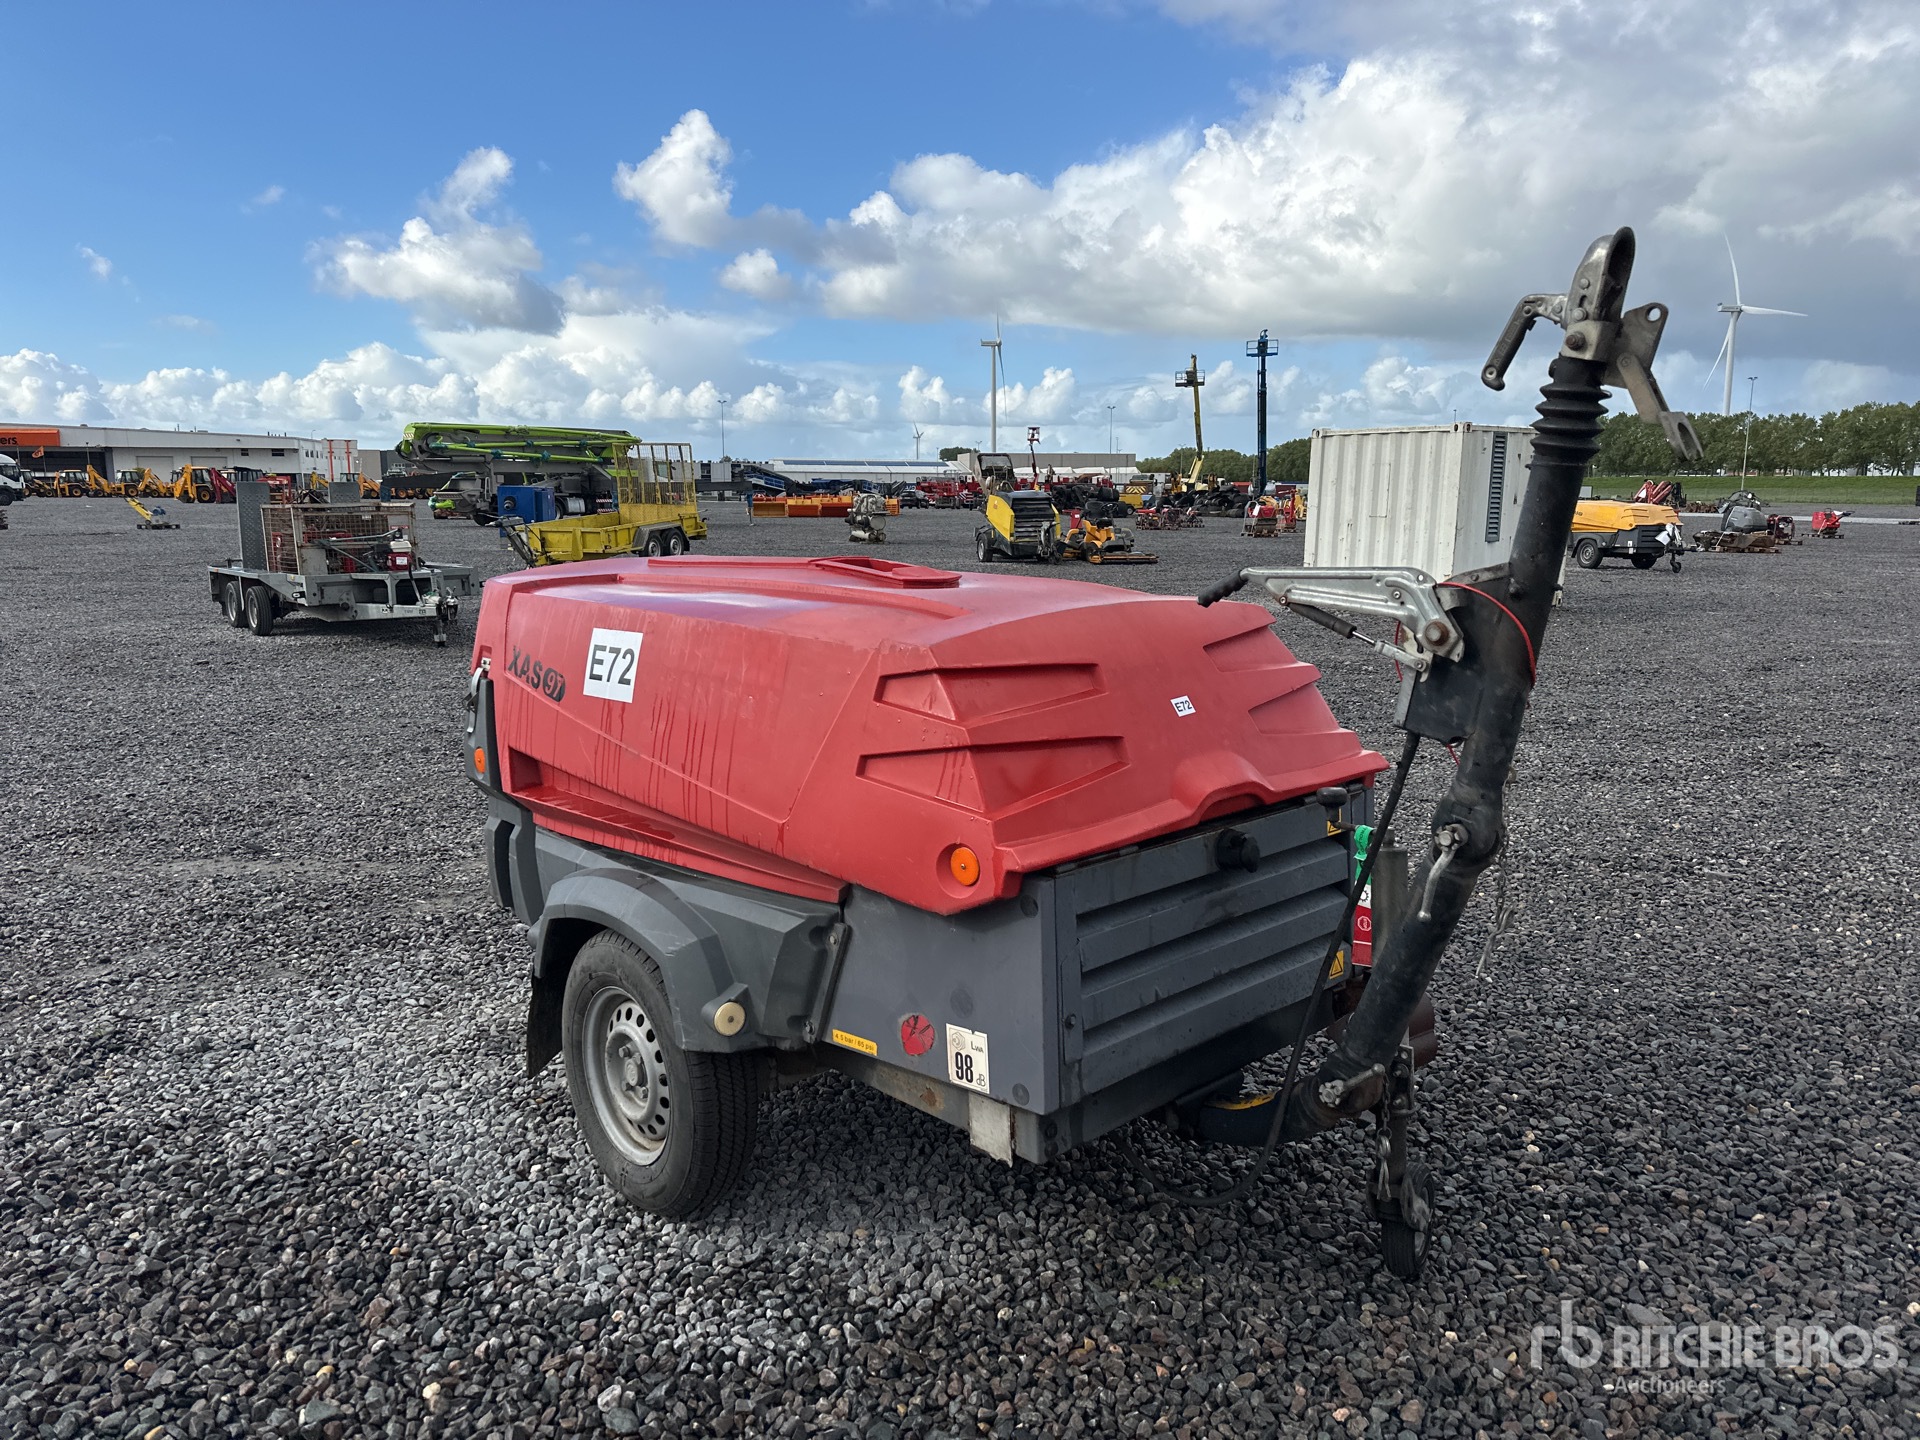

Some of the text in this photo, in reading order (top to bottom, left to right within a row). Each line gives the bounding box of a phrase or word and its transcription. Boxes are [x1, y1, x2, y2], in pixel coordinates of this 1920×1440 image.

[588, 644, 635, 686] E72
[1174, 699, 1193, 712] E72
[955, 1051, 974, 1084] 98
[976, 1073, 986, 1087] dB
